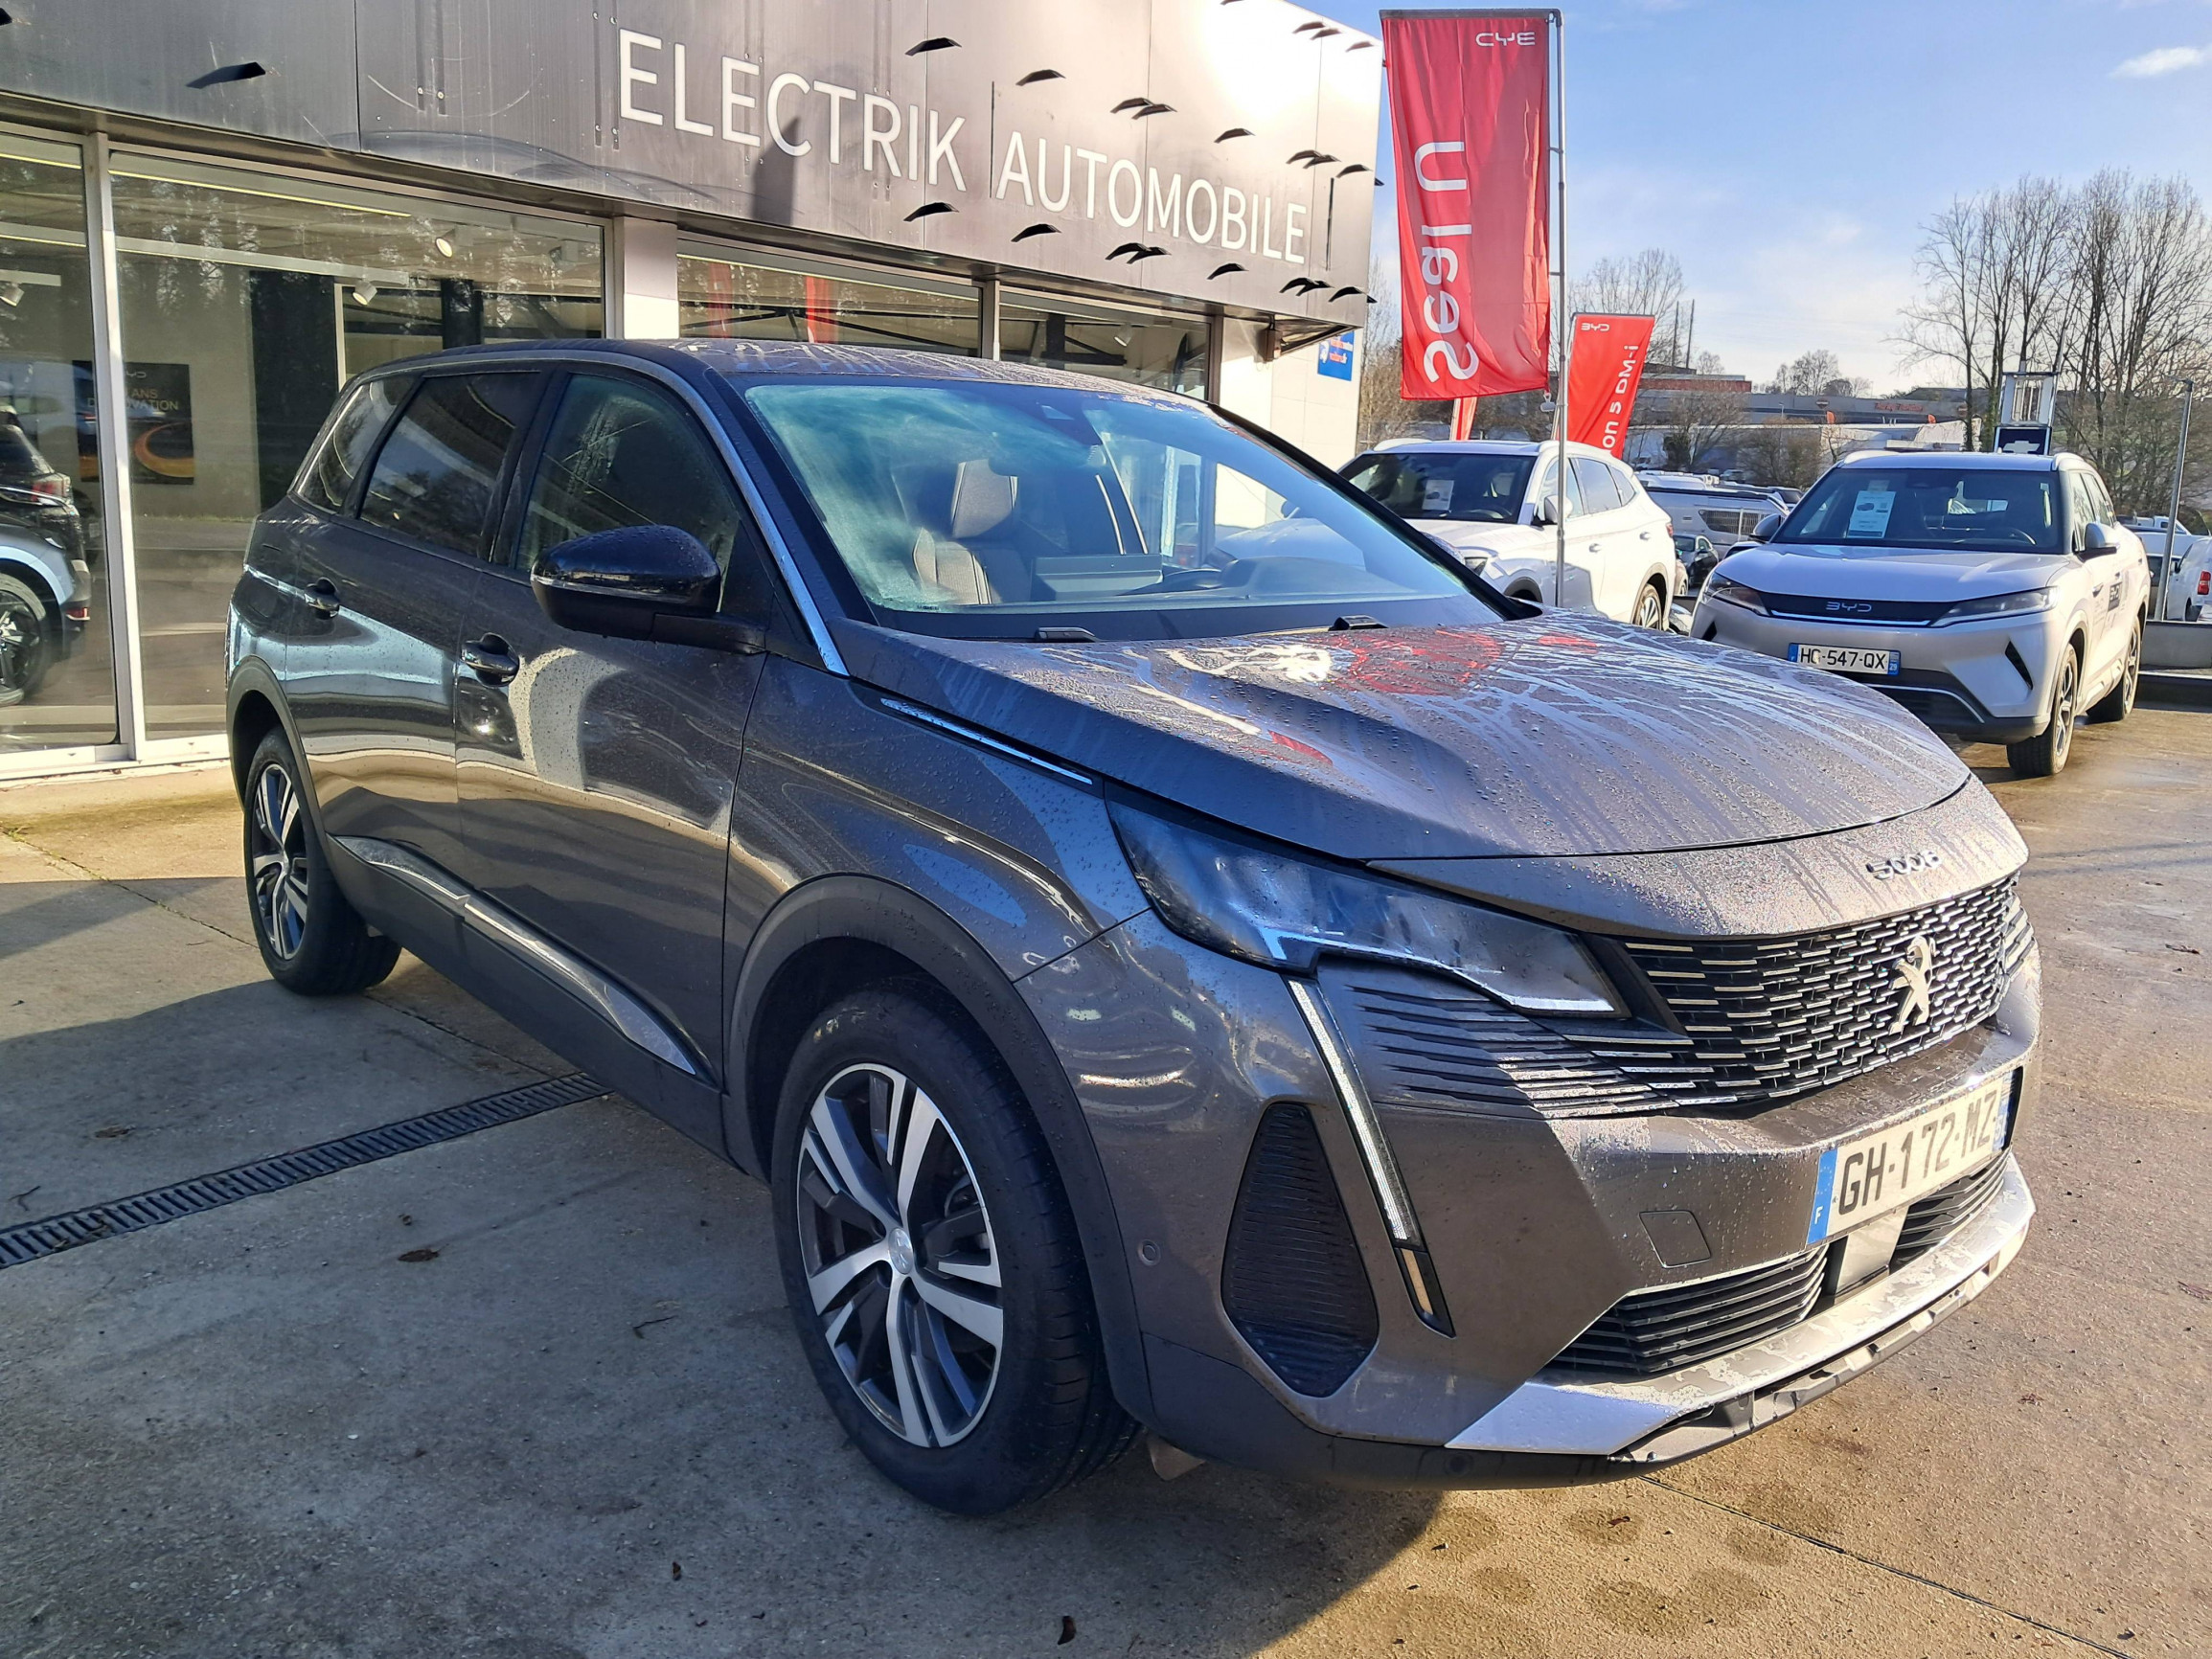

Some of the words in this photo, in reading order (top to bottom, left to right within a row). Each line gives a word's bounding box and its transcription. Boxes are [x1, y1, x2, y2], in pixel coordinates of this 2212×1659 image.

[620, 28, 968, 193] ELECTRIK
[994, 130, 1309, 265] AUTOMOBILE
[1581, 322, 1610, 331] BYD
[1614, 345, 1640, 395] DM-i
[1608, 400, 1623, 415] 5
[1825, 601, 1872, 613] BYD
[1837, 1090, 1997, 1216] GH-172-MZ
[1813, 1206, 1823, 1225] F
